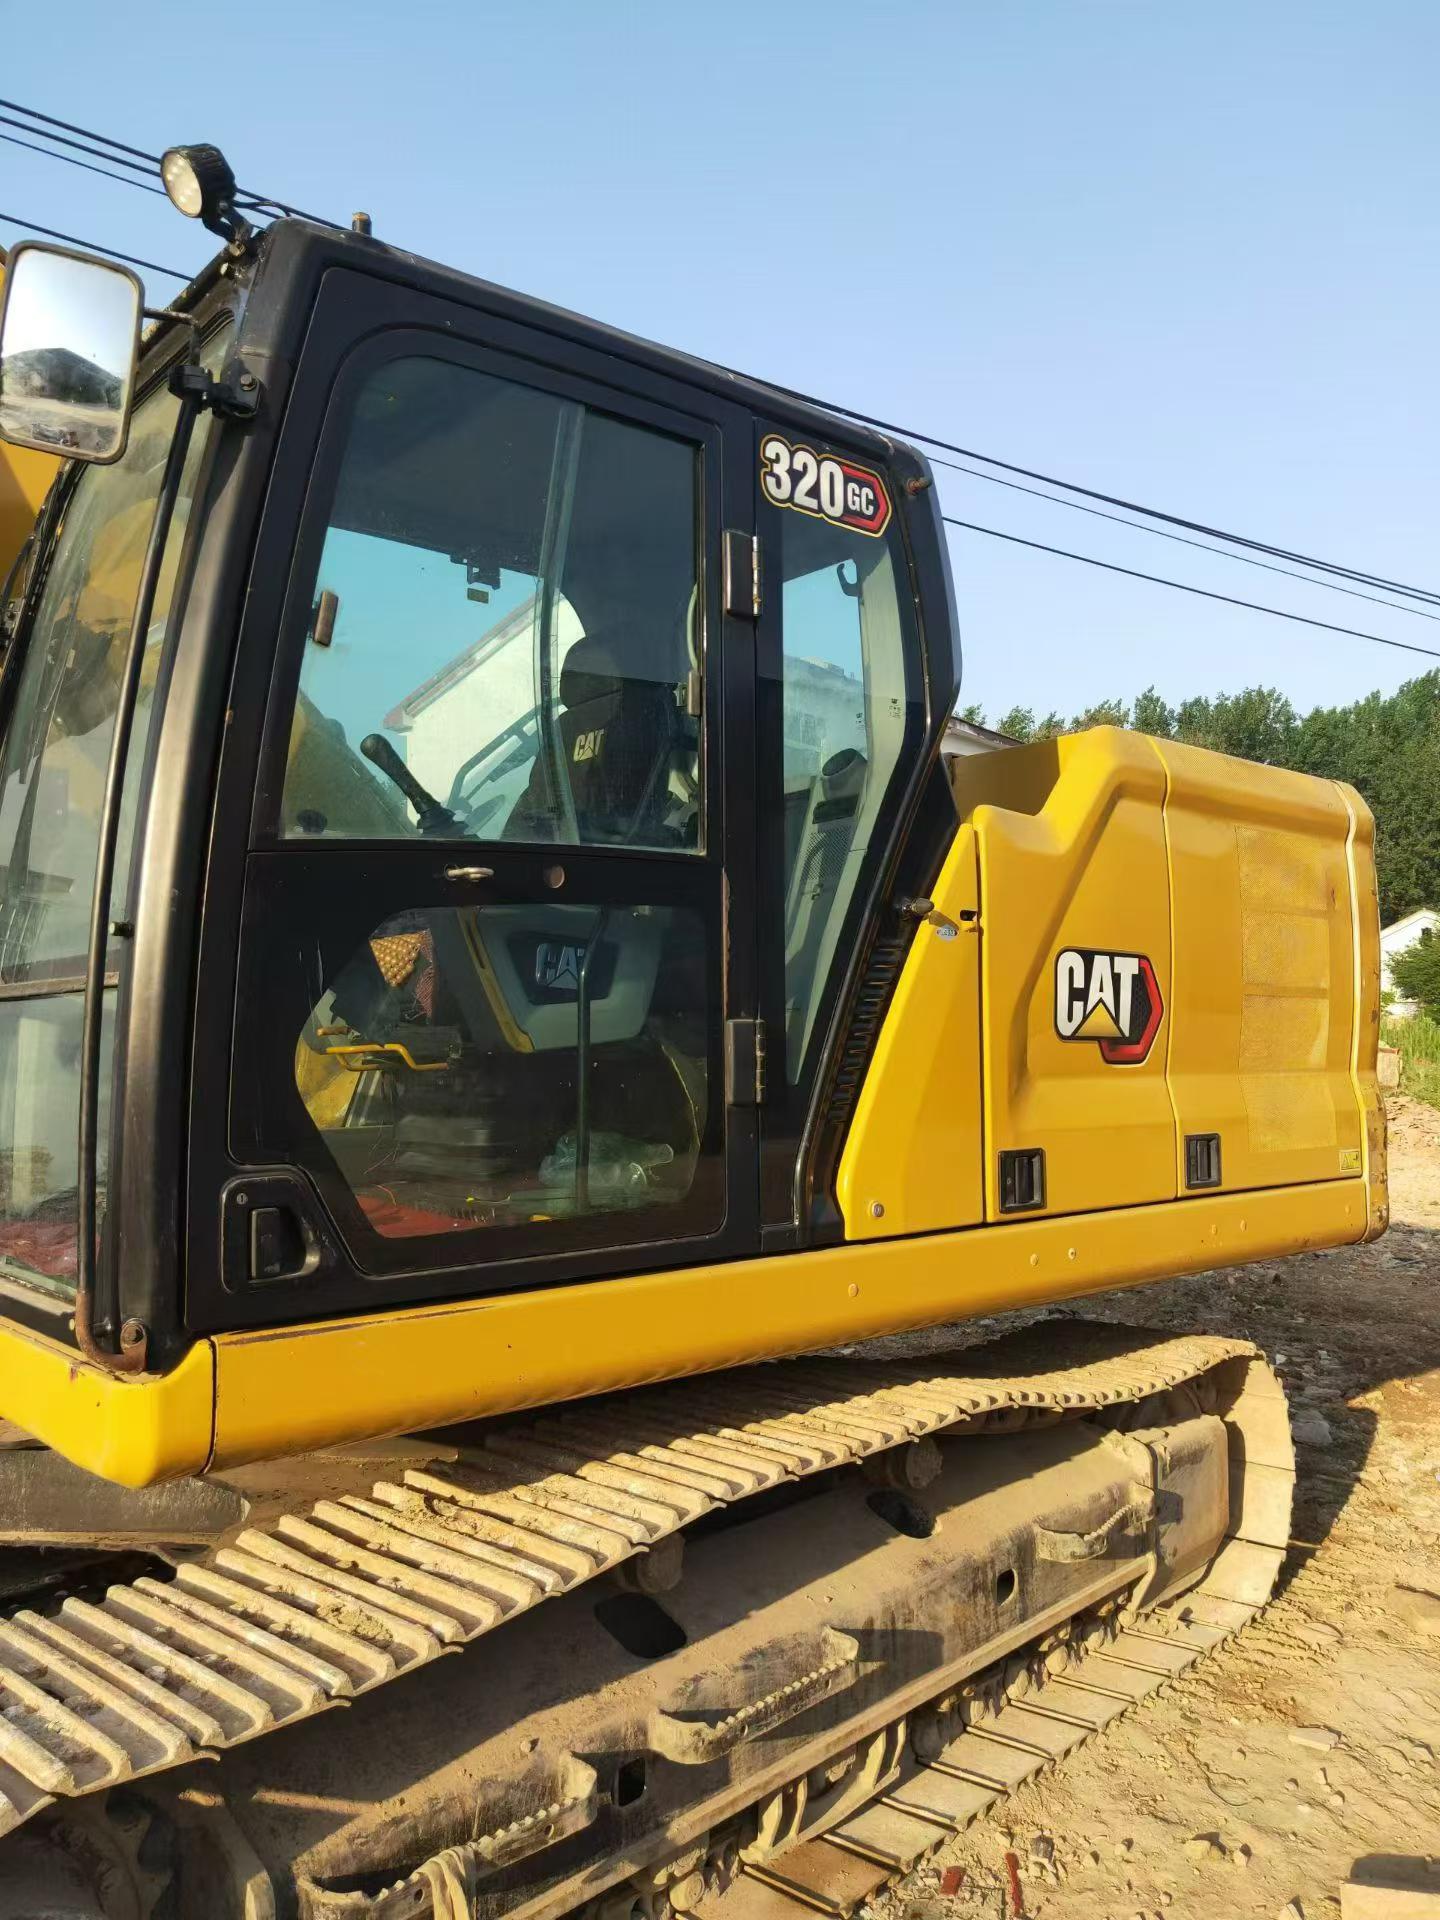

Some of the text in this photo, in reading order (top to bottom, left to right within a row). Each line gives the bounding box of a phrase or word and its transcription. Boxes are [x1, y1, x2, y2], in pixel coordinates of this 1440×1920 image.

[764, 440, 874, 518] 320 GC
[573, 728, 605, 762] CAT
[535, 942, 586, 988] CA
[1056, 950, 1139, 1038] CAT
